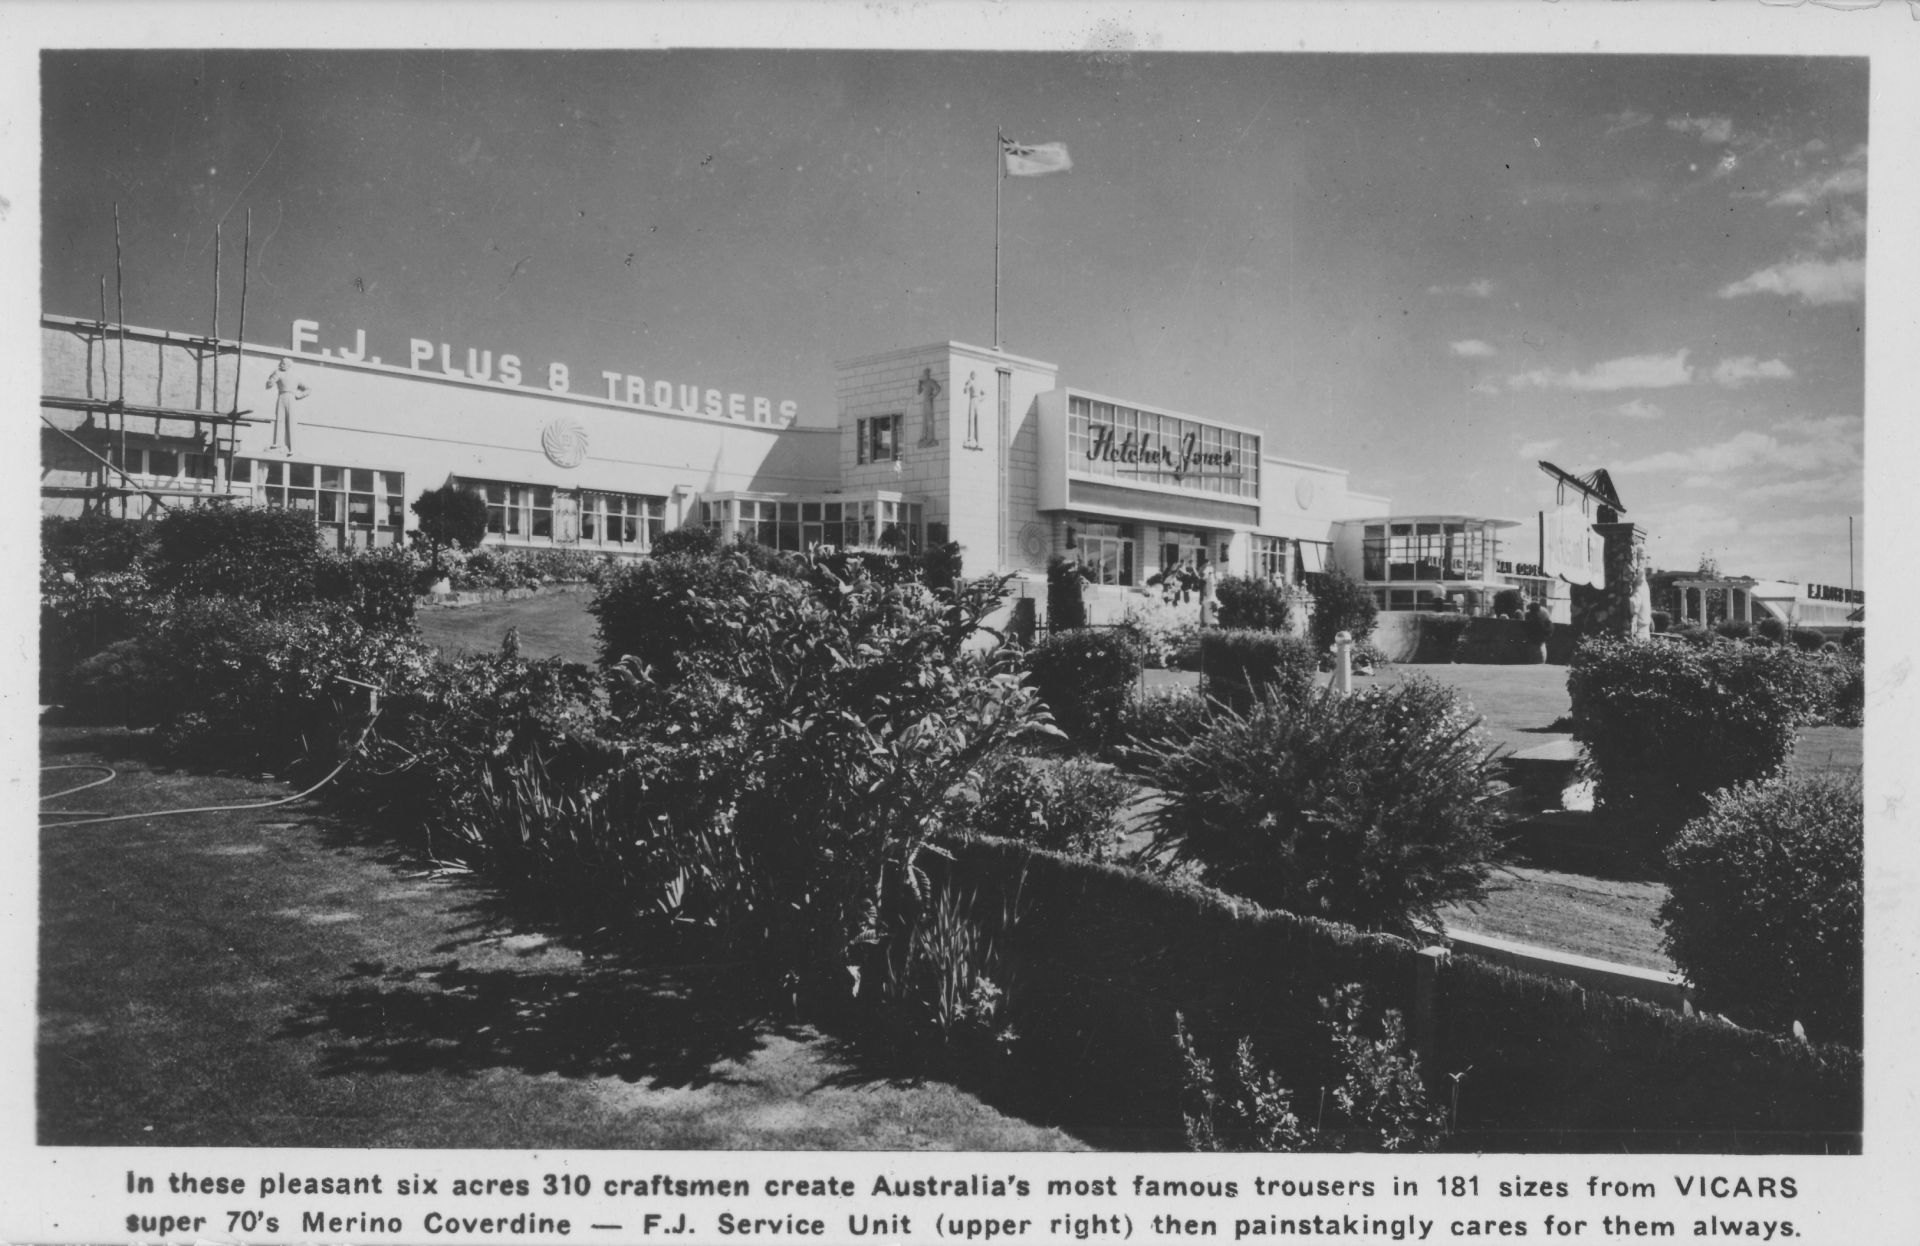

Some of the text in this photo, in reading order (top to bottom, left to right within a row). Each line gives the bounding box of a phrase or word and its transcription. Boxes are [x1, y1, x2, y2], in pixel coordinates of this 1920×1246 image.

[292, 319, 798, 427] F.J. PLUS 8 TROUSERS
[1086, 424, 1232, 479] Fletcher Jones
